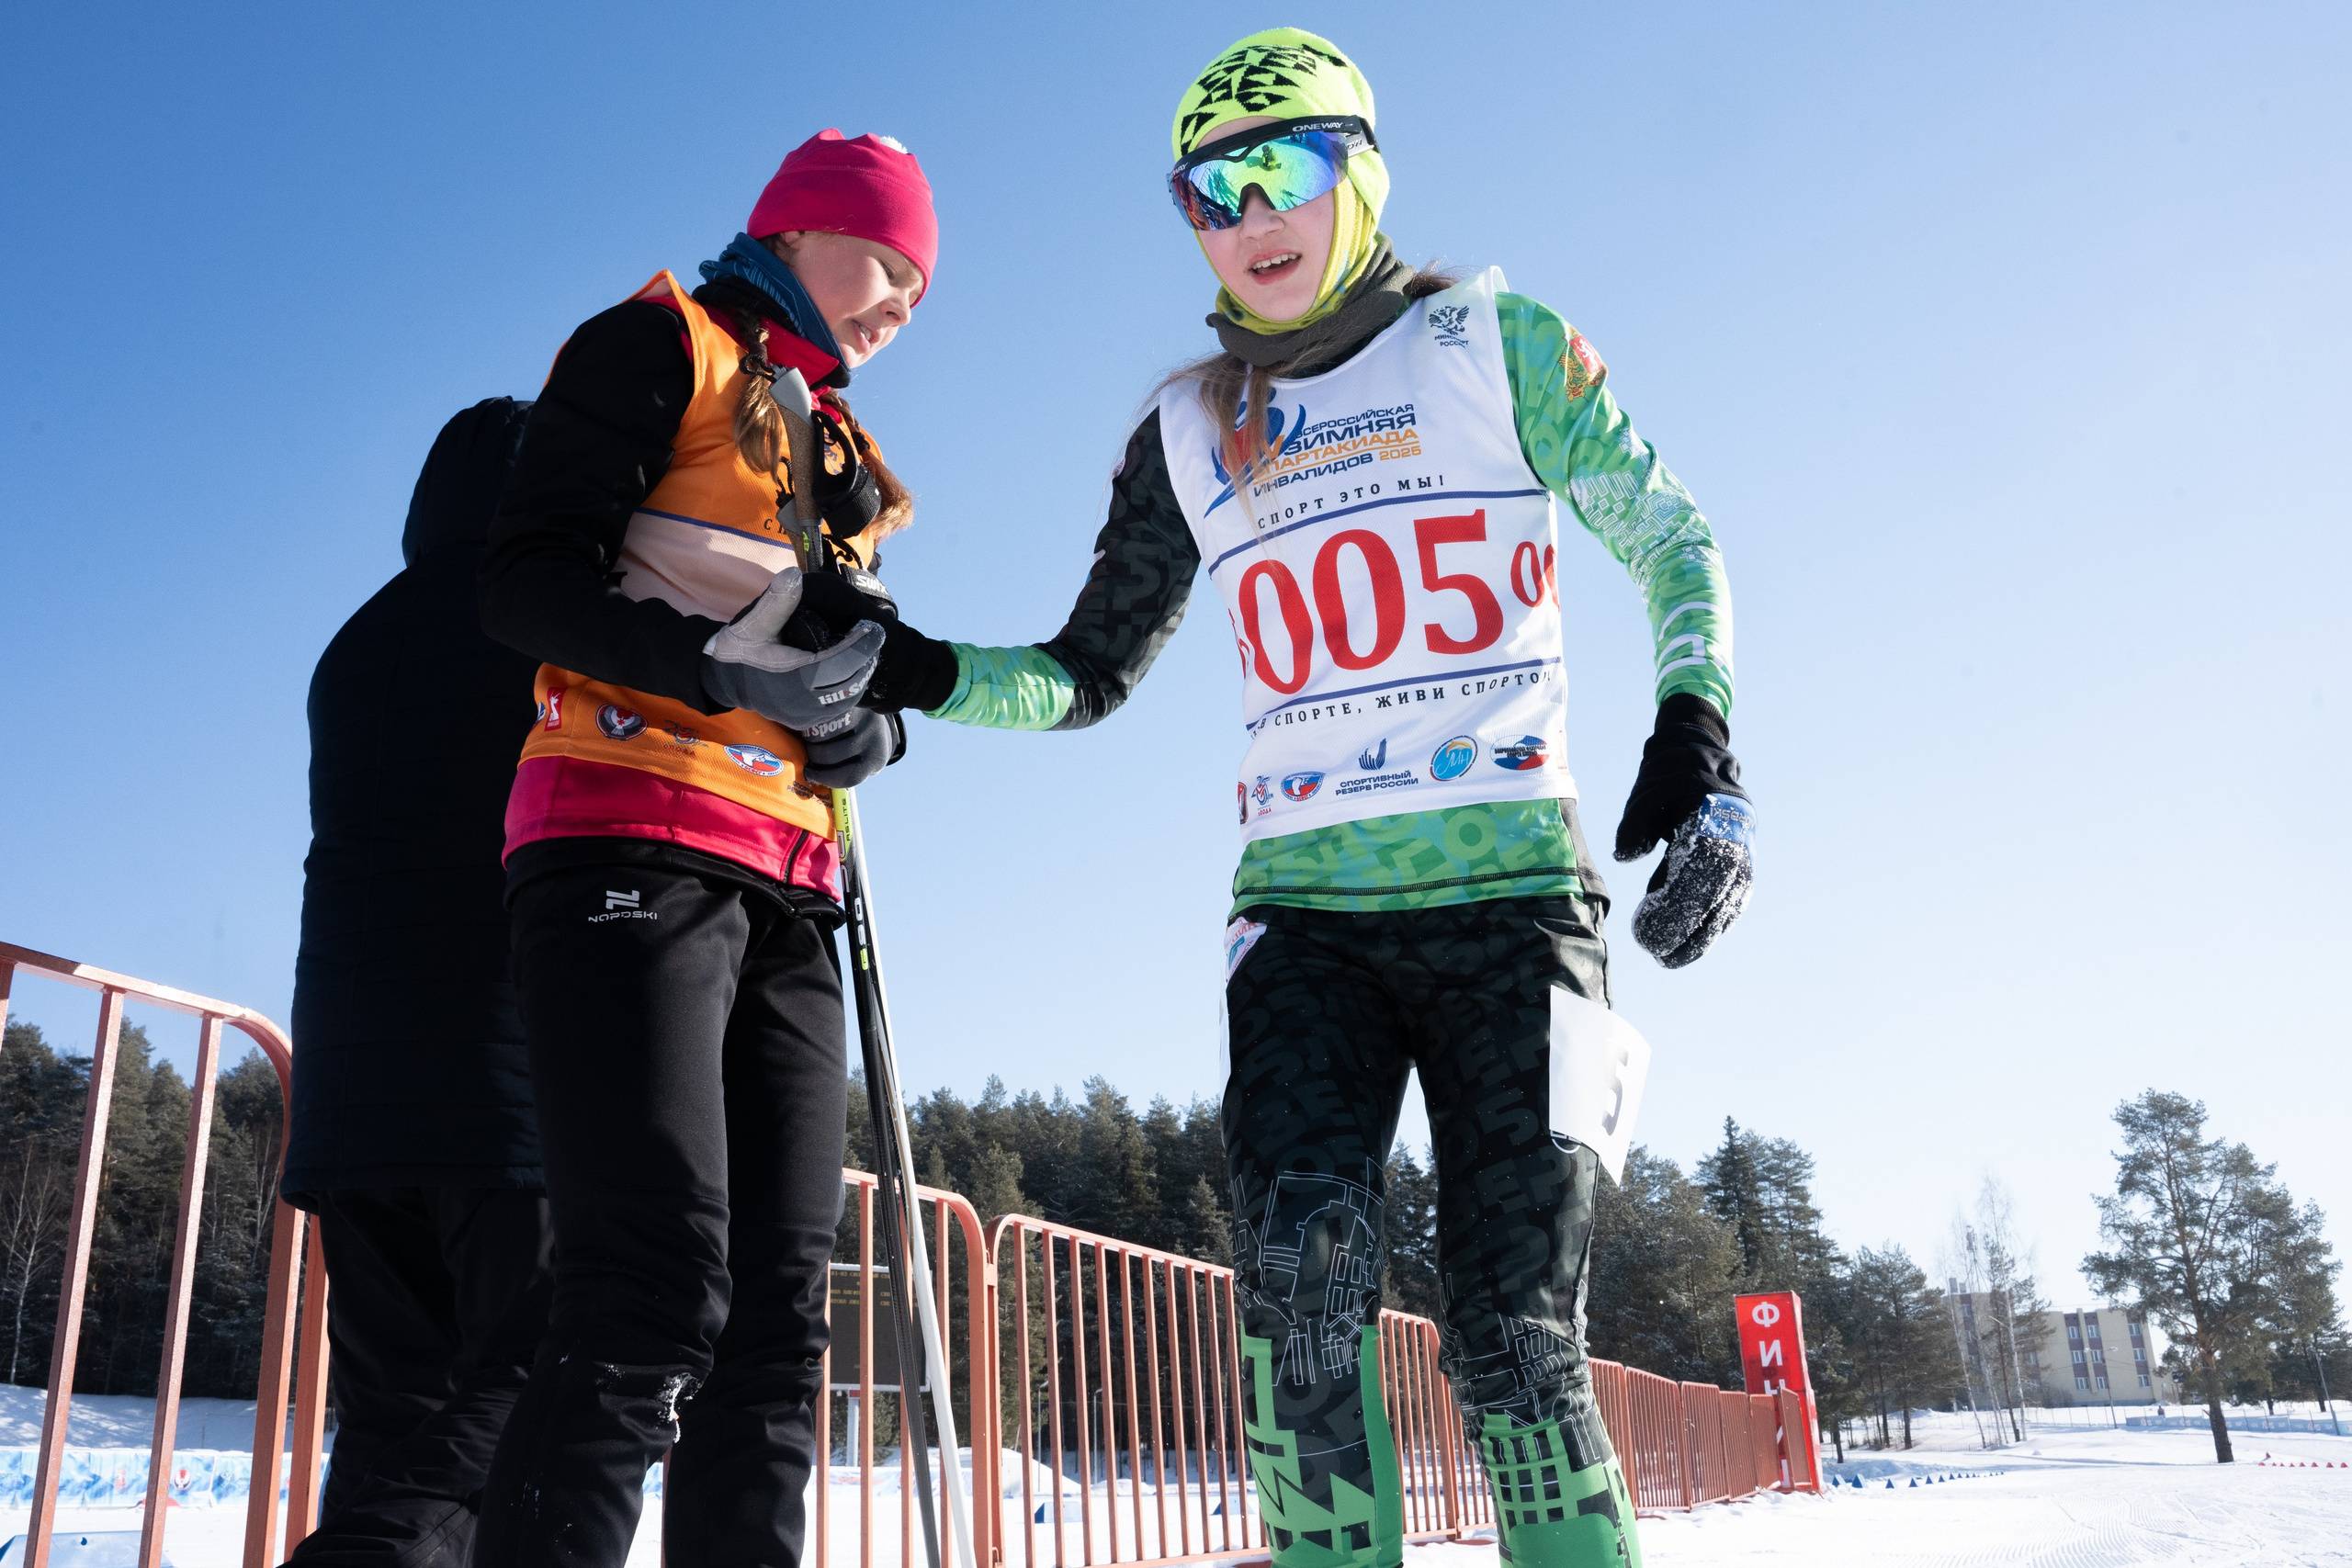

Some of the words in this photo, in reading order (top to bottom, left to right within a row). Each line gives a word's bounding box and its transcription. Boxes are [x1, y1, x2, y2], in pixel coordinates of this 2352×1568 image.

[1292, 121, 1343, 132] ONEWAY
[1434, 333, 1469, 345] МИНСТ
[1440, 340, 1466, 349] РОСС
[1295, 403, 1414, 439] ВСЕРОССИЙСКАЯ
[1283, 413, 1417, 456] ЗИМНЯЯ
[1253, 453, 1374, 497] ИНВАЛИДОВ
[1379, 446, 1422, 461] 2025
[1257, 497, 1325, 530] СПОРТ
[1340, 482, 1382, 505] ЭТО
[1397, 474, 1446, 491] МЫ!
[1238, 508, 1504, 695] 005
[1375, 686, 1445, 709] ЖИВИ
[1335, 784, 1372, 796] РЕЗЕРВ
[1374, 778, 1419, 790] РОССИИ
[1340, 770, 1412, 788] СПОРТИВНЫЙ
[588, 910, 658, 923] NORDSKI
